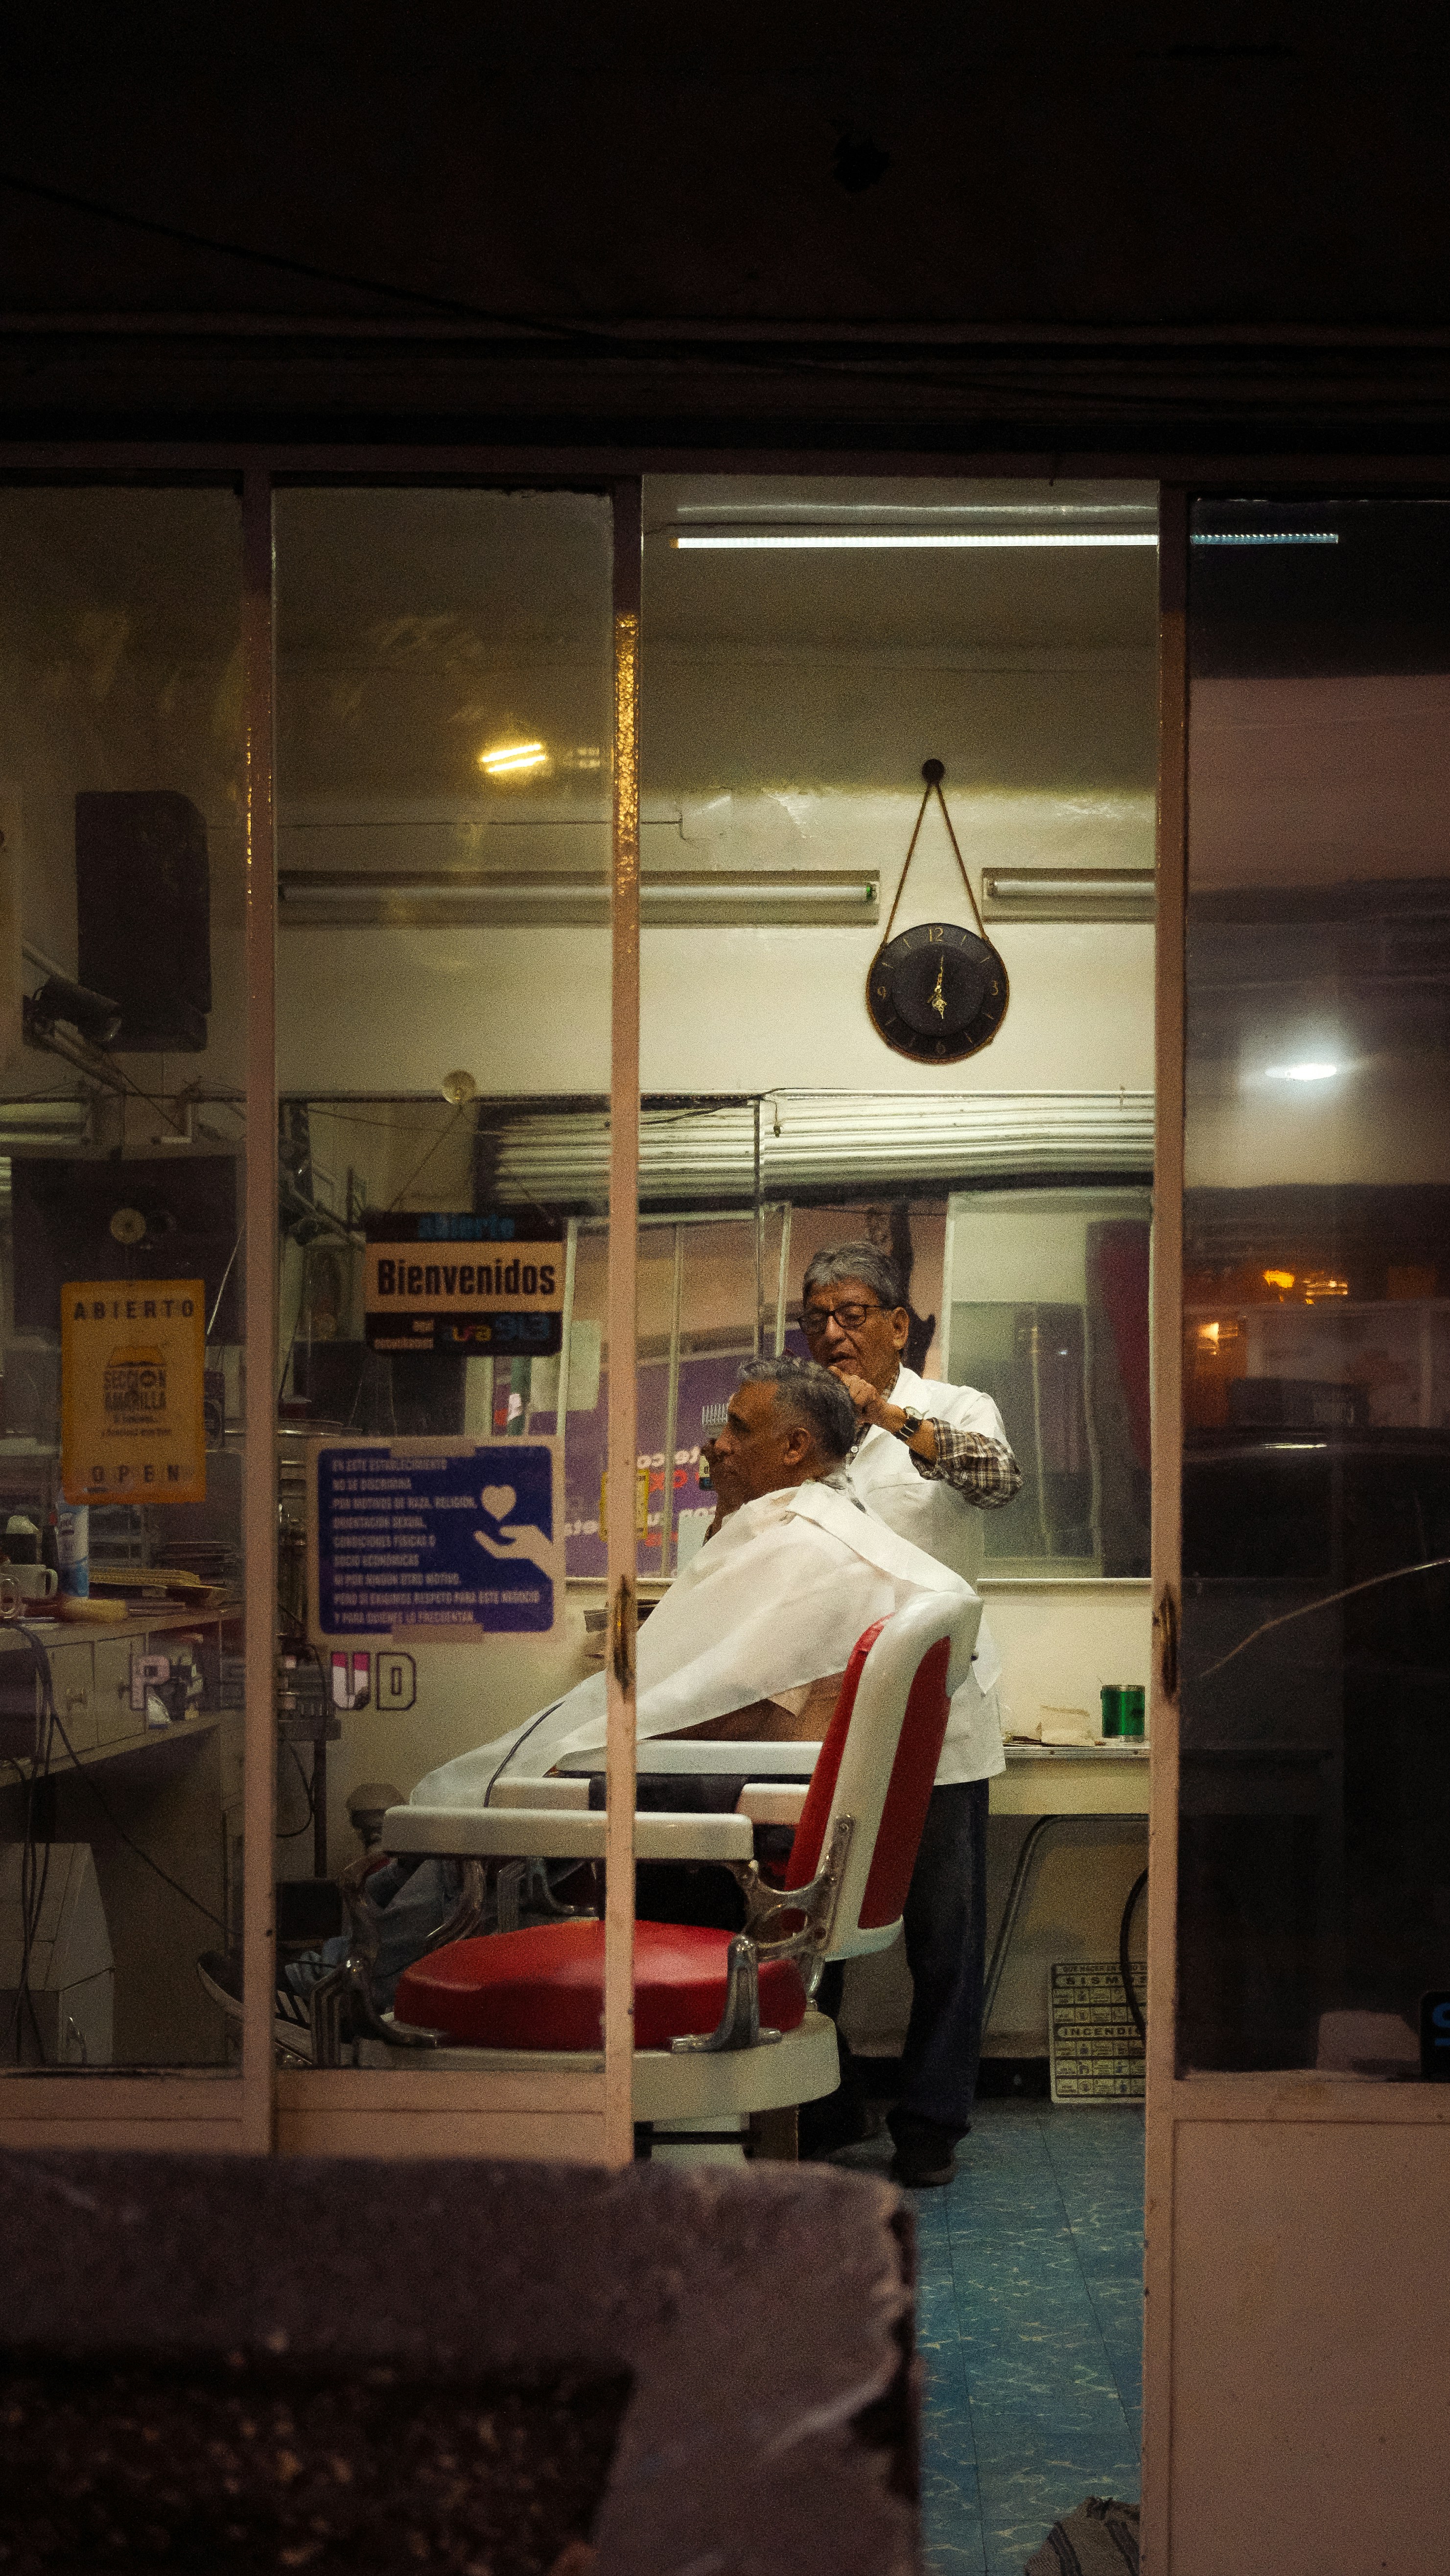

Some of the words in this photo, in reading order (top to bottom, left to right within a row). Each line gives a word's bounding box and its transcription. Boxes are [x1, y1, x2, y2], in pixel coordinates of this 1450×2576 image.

[928, 927, 944, 942] 12
[877, 986, 887, 999] 9
[992, 980, 999, 996] 3
[377, 1258, 555, 1296] Bienvenidos
[74, 1299, 194, 1321] ABIERTO
[91, 1464, 180, 1483] OPEN
[332, 1479, 346, 1491] NO
